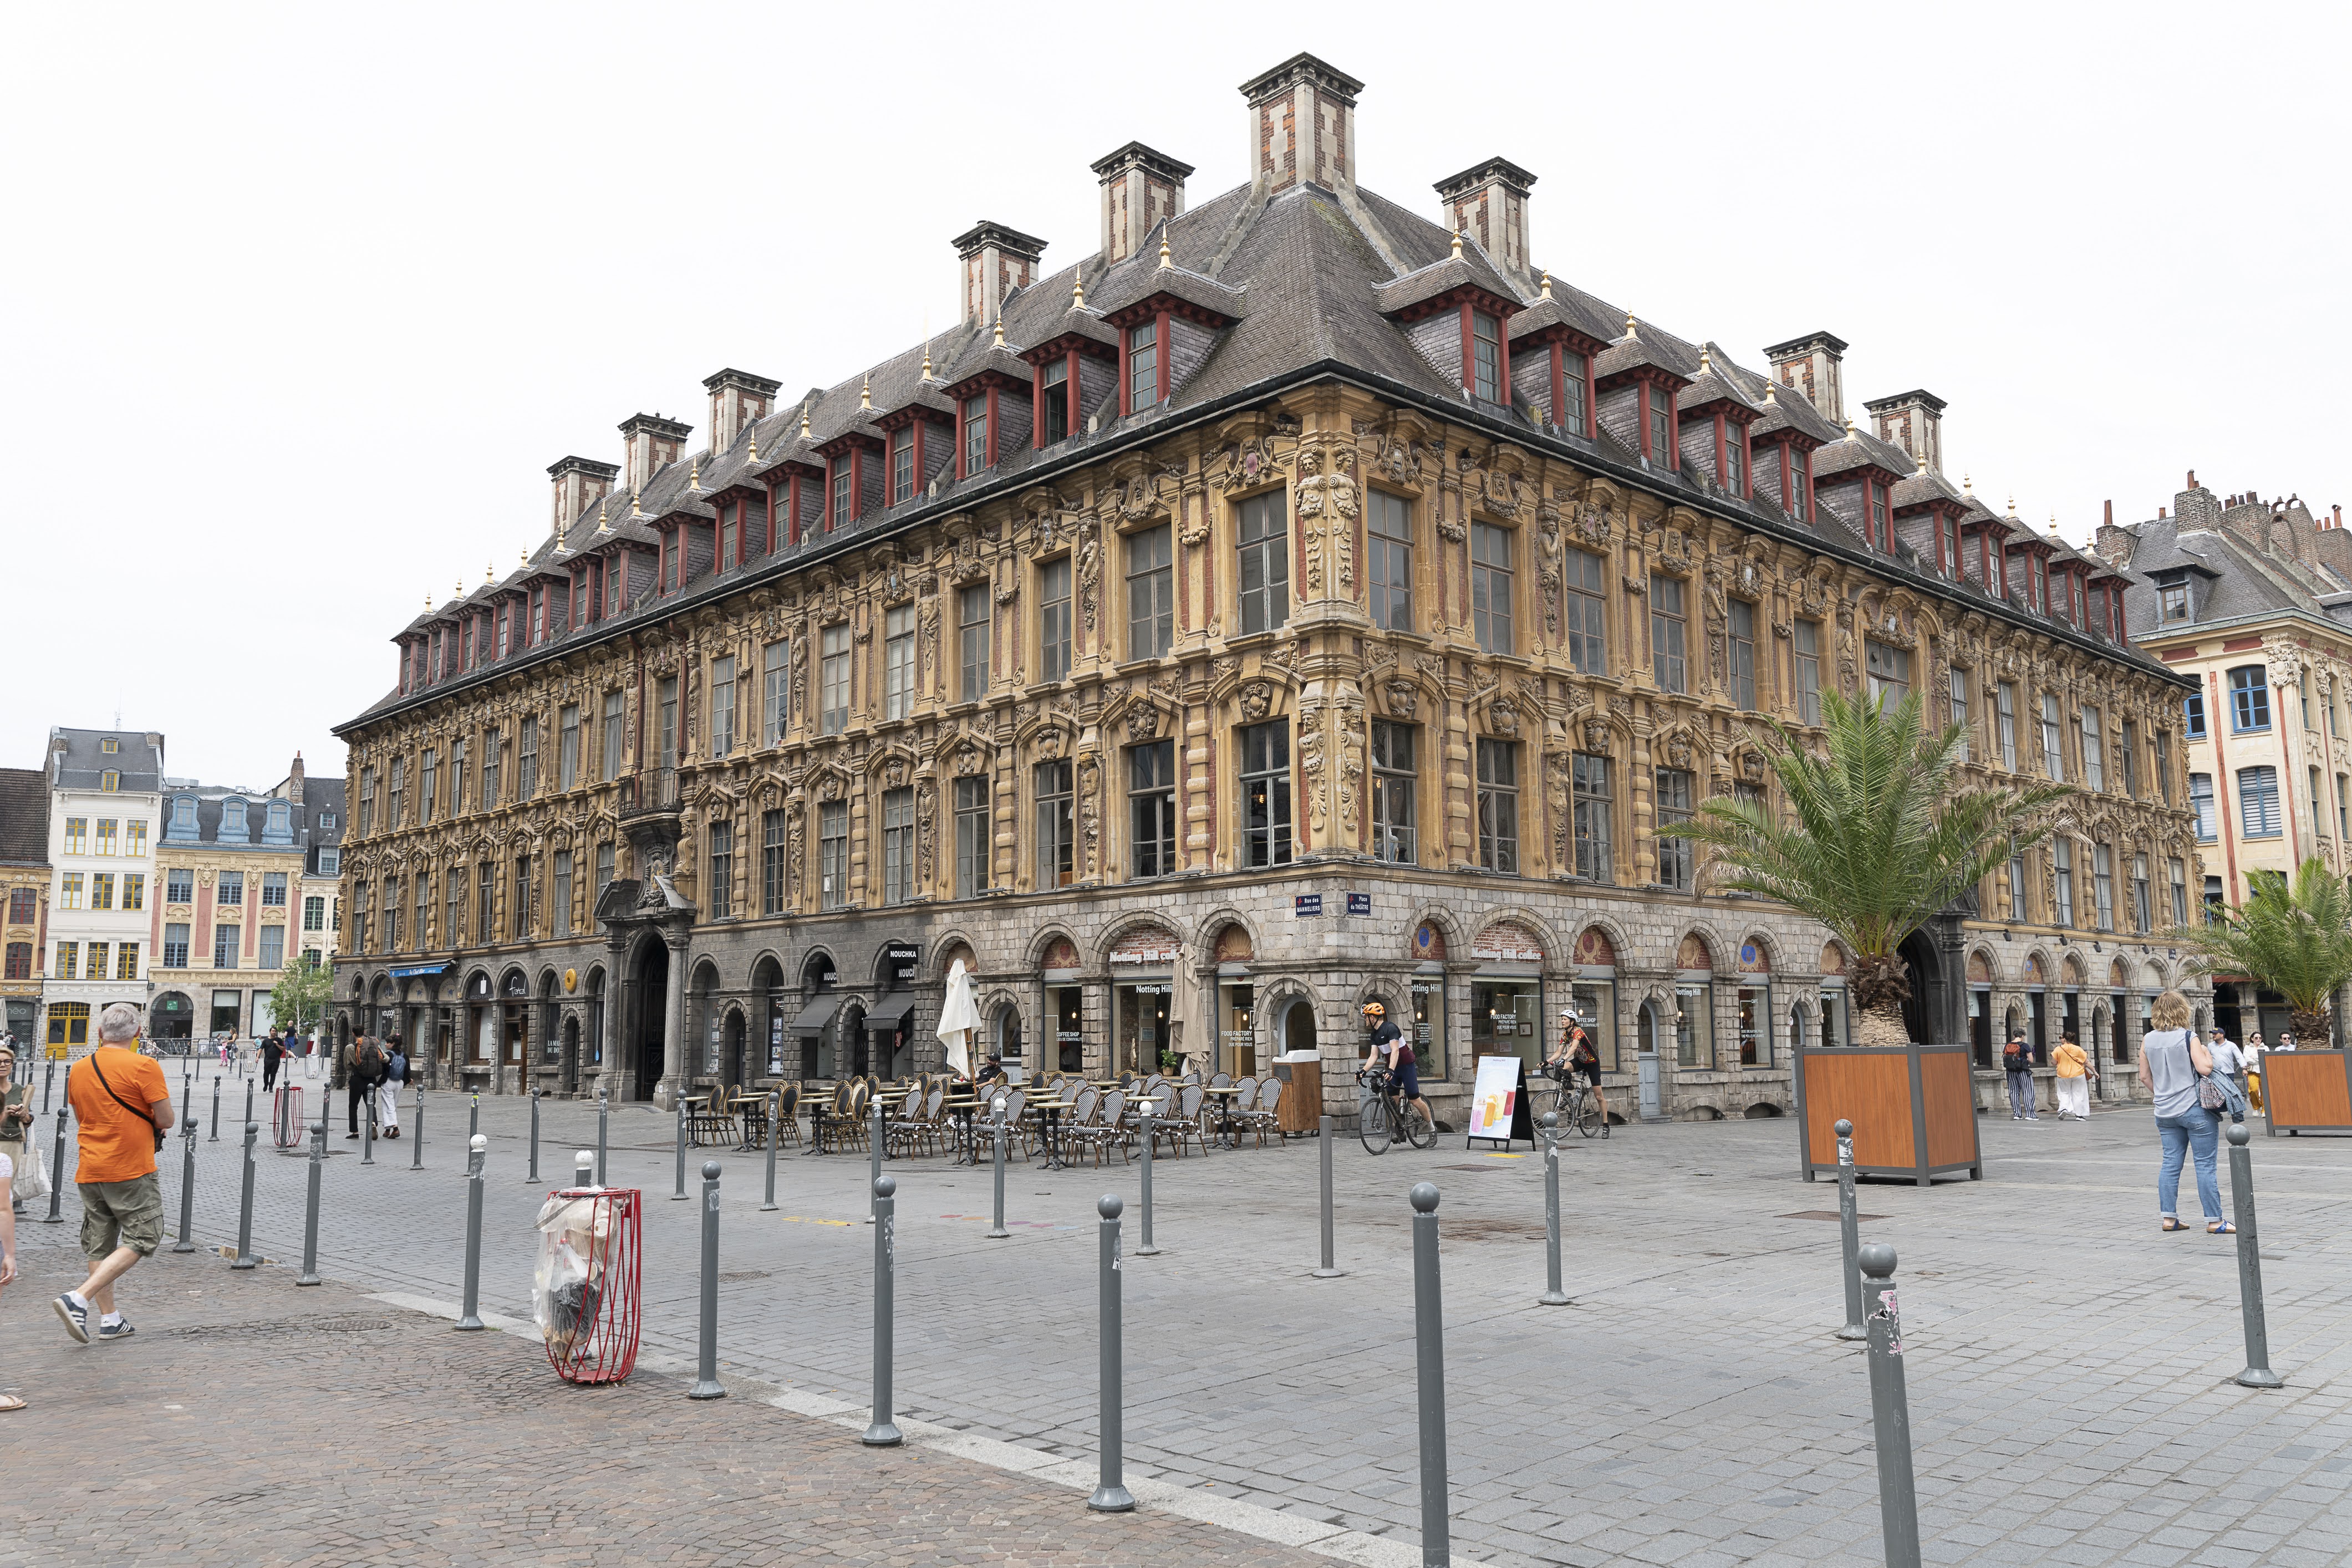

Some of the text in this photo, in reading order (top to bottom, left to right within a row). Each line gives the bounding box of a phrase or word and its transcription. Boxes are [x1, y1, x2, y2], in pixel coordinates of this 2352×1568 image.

[1109, 949, 1177, 963] Notting Hill coff
[1471, 947, 1541, 961] Notting Hill coffee
[823, 972, 837, 981] NOUC
[899, 969, 914, 978] NOUC
[1136, 984, 1172, 994] Notting Hill
[1411, 984, 1441, 994] otting Hill
[1820, 992, 1830, 1000] otting
